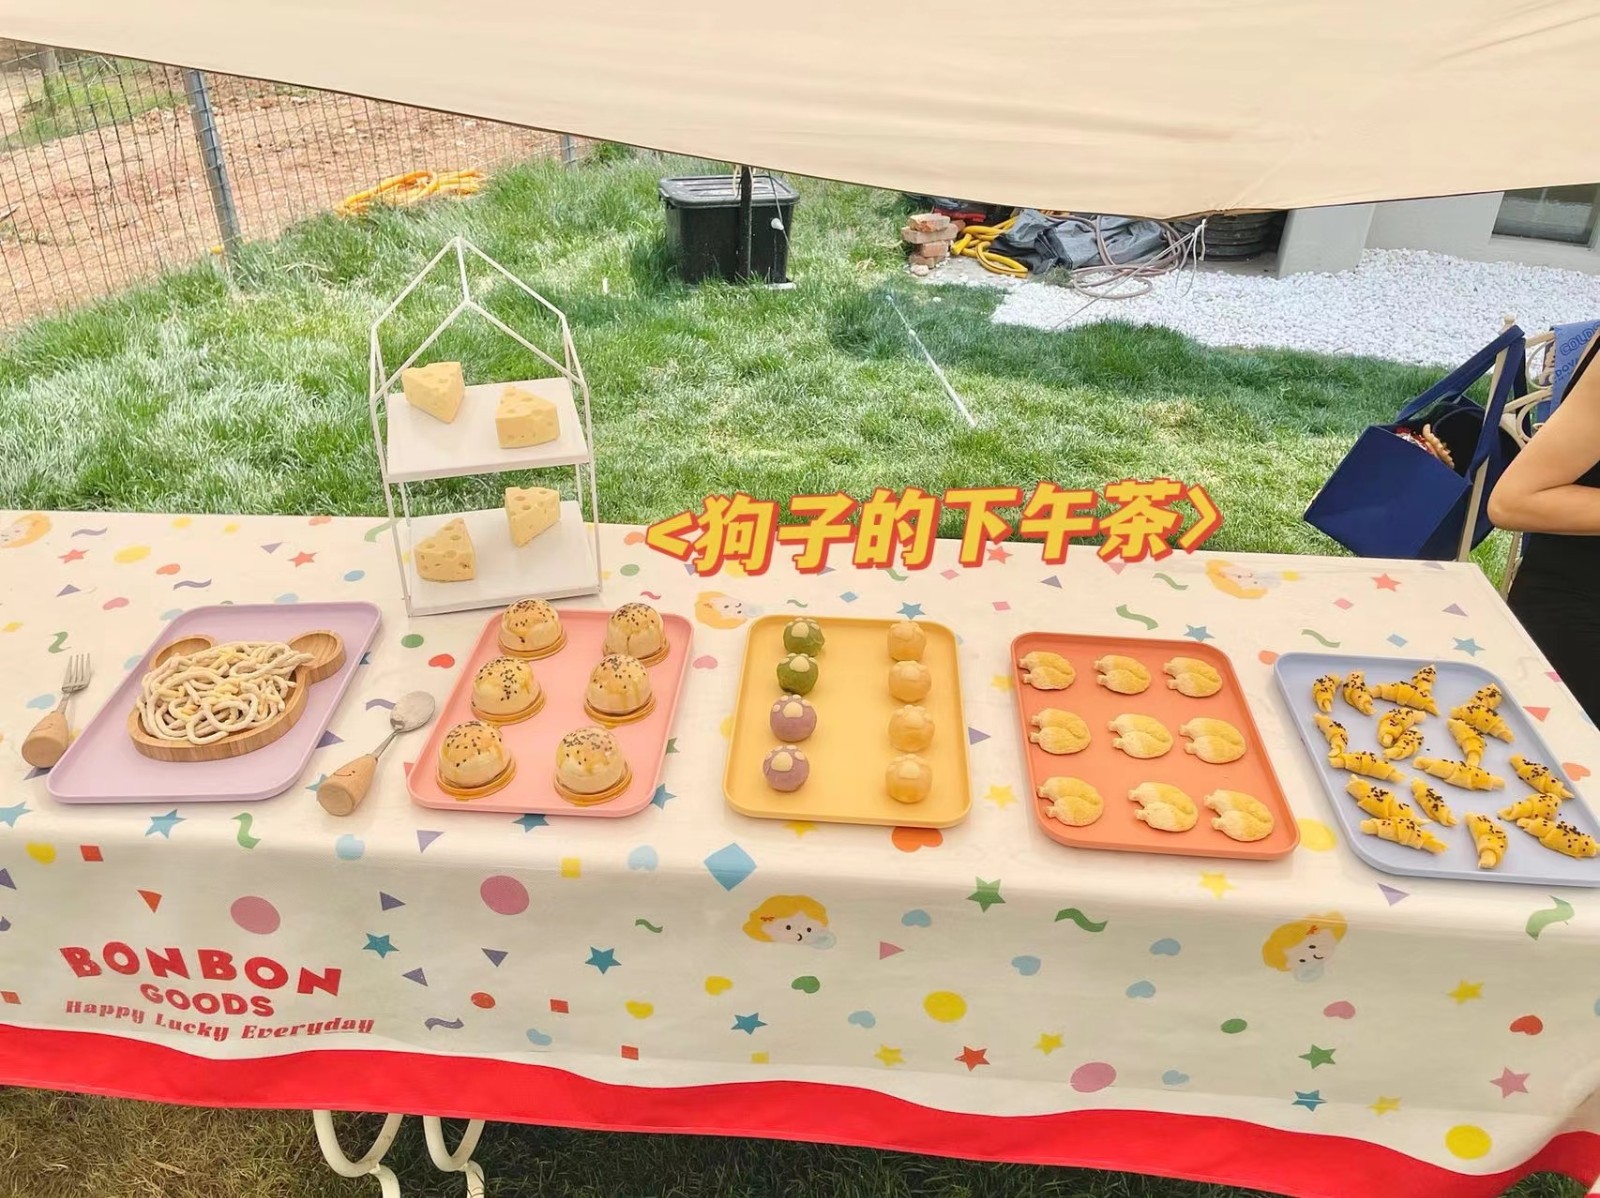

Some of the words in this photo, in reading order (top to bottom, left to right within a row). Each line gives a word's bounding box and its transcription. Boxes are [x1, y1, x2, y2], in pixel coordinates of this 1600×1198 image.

[59, 941, 342, 997] BONBON
[65, 1000, 145, 1024] Happy
[155, 1013, 229, 1042] Lucky
[241, 1017, 375, 1040] Everyday
[140, 983, 275, 1017] GOODS
